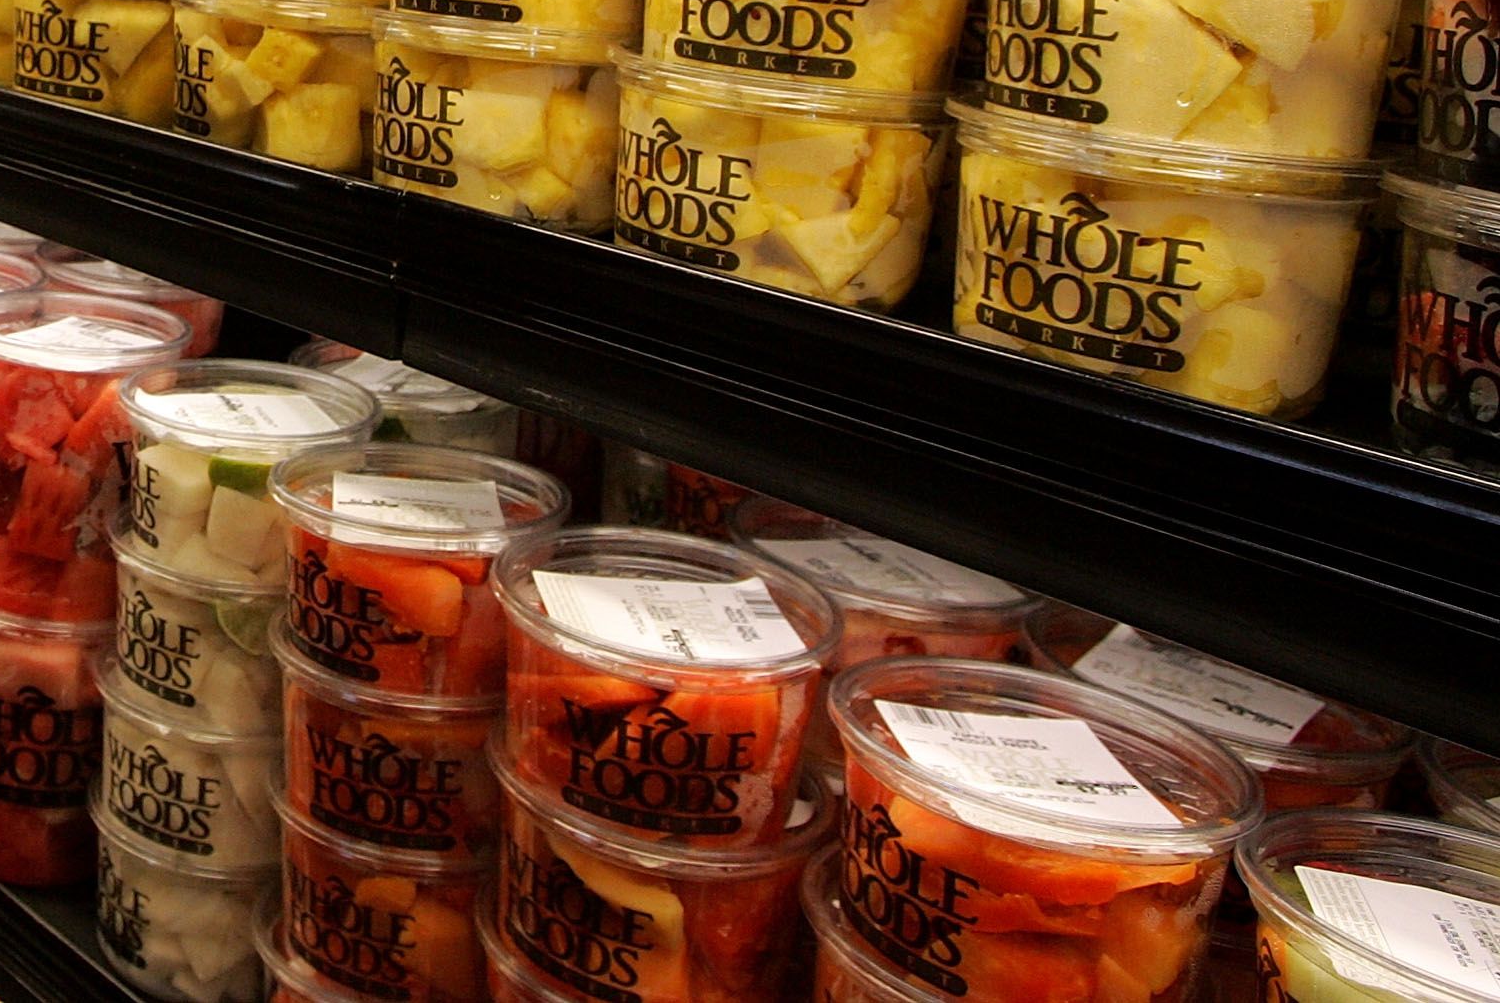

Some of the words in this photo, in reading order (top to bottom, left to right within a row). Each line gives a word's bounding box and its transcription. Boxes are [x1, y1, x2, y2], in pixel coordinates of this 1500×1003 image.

[678, 40, 850, 77] MARKET
[986, 25, 1102, 95] OODS
[616, 181, 737, 247] FOODS
[978, 194, 1206, 291] WHOLE
[982, 252, 1183, 344] FOODS
[980, 303, 1178, 371] MARKET
[121, 595, 201, 662] HOLE
[307, 724, 464, 795] WHOLE
[561, 699, 757, 773] WHOLE
[107, 733, 221, 810] WHOLE
[567, 747, 741, 814] FOODS
[107, 773, 212, 841] FOODS
[311, 776, 454, 836] FOODS
